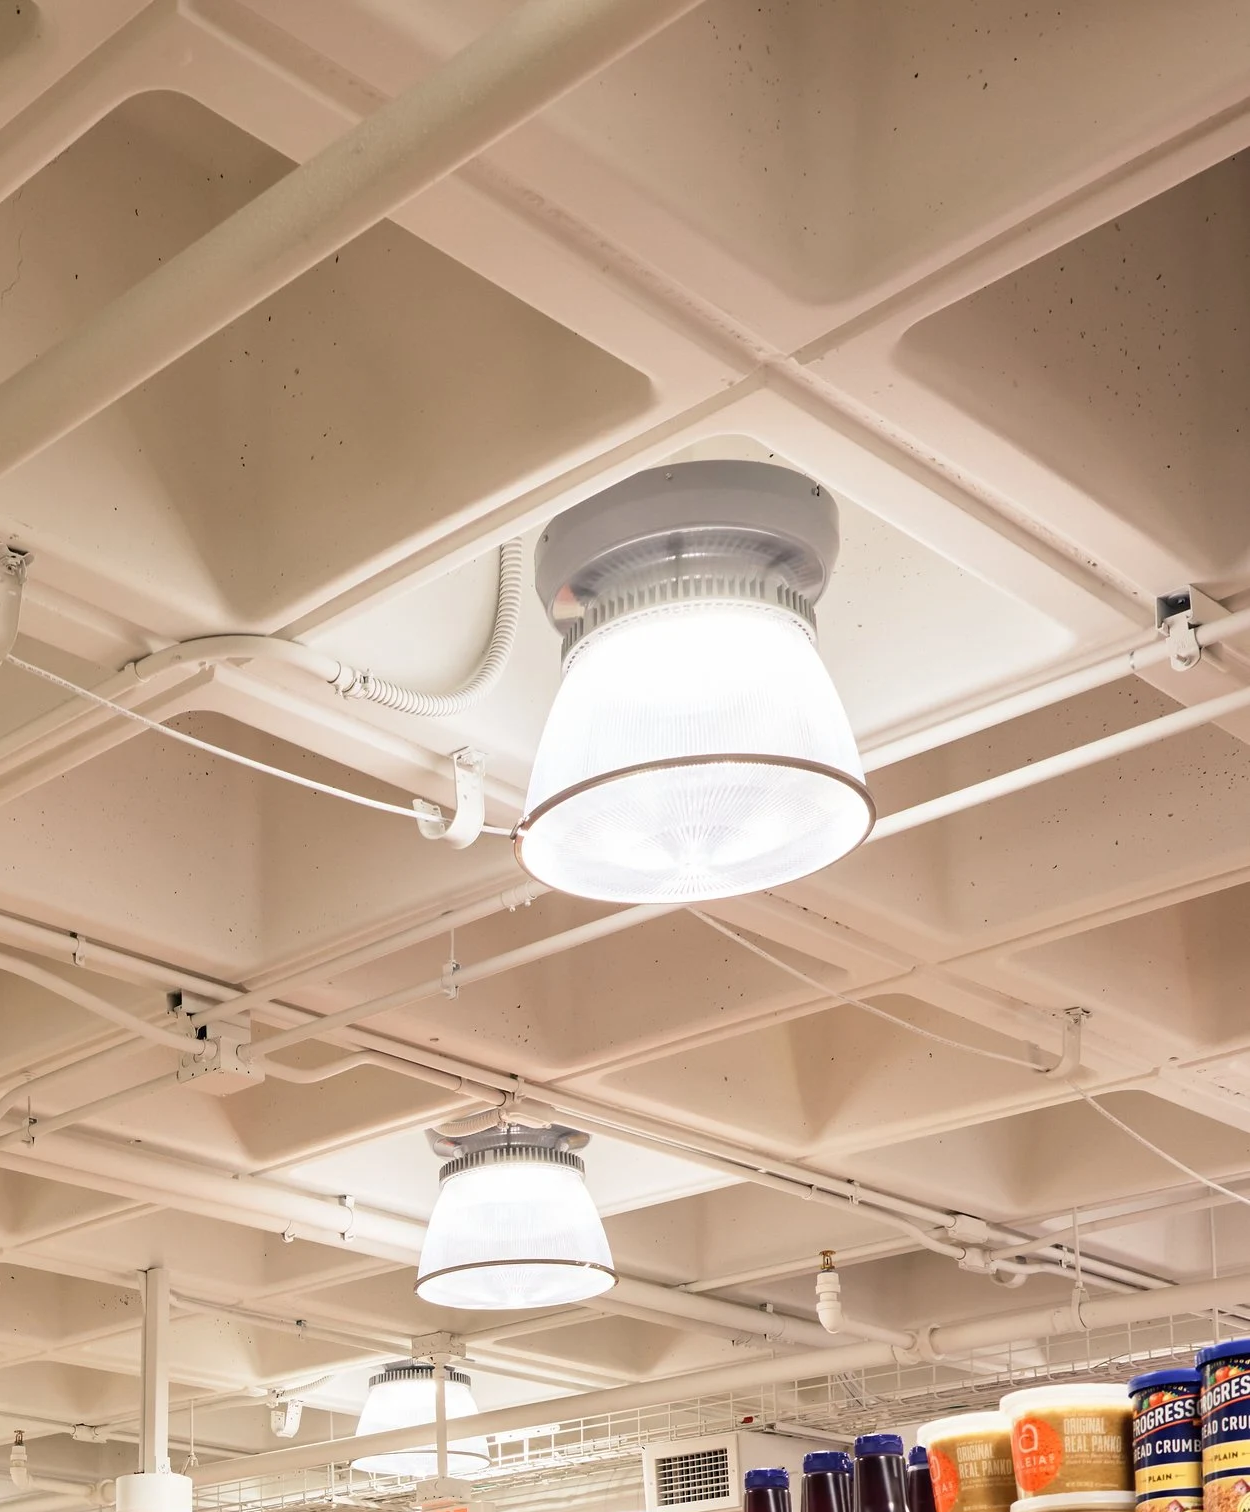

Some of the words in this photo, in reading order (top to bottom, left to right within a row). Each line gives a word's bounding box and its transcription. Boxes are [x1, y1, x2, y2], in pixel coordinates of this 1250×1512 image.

[1063, 1417, 1106, 1435] ORIGINAL
[957, 1443, 993, 1461] ORIGINAL
[1064, 1436, 1089, 1453] REAL
[1092, 1435, 1122, 1453] PANKO
[1214, 1452, 1238, 1462] PLAIN
[959, 1461, 979, 1478] REAL
[982, 1458, 1012, 1475] PANKO
[1148, 1473, 1172, 1483] PLAIN
